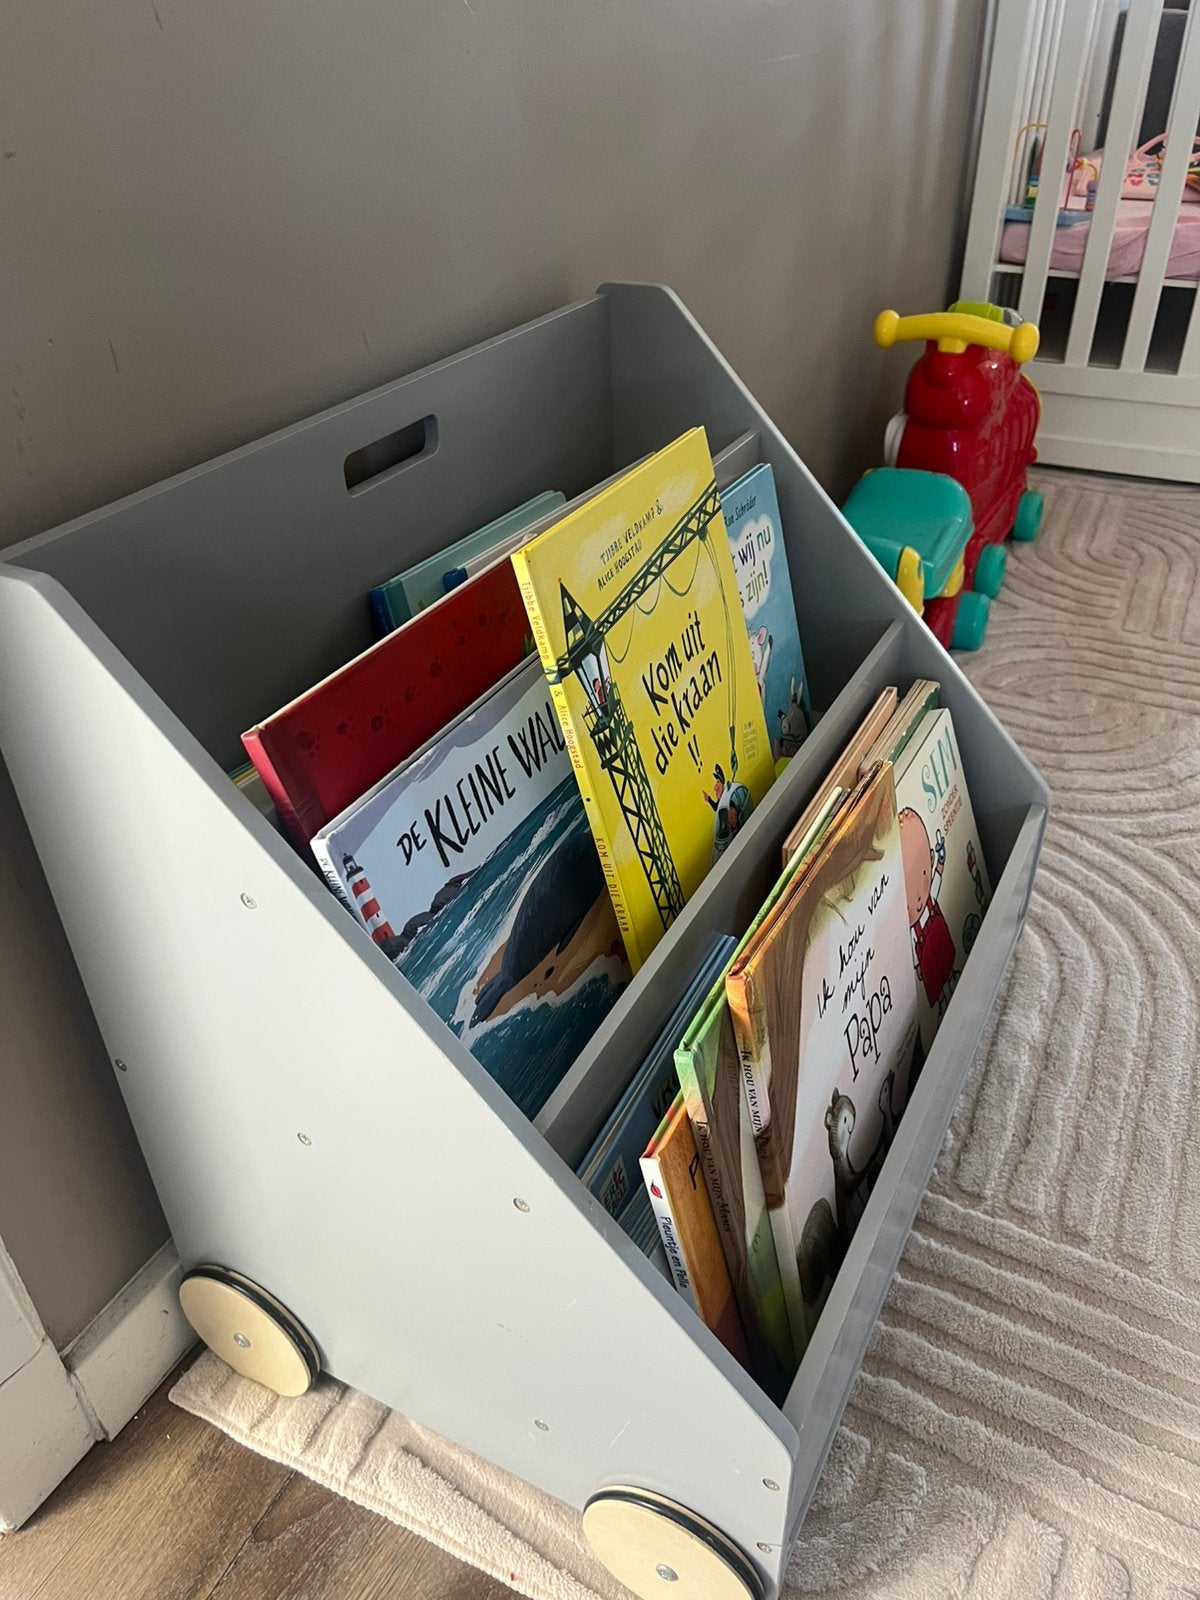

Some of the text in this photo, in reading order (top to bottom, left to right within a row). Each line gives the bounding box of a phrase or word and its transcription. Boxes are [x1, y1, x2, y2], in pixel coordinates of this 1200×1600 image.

[623, 507, 655, 544] VELDKAMP
[655, 499, 664, 515] &
[738, 533, 756, 567] wij
[757, 526, 771, 551] nu
[597, 538, 643, 591] ALICE HOOGSTAD
[745, 560, 769, 603] zijn!
[521, 581, 535, 612] Tjibbe
[532, 615, 549, 660] Veldkamp
[557, 705, 569, 726] Alice
[565, 729, 584, 769] Hoogstad
[642, 610, 706, 717] Kom uit
[650, 650, 722, 776] die kraan
[921, 725, 957, 814] SEM
[396, 820, 428, 867] DE
[423, 745, 516, 868] KLEINE
[596, 837, 630, 933] KOM UIT DIE KRAAN
[838, 924, 866, 980] hou
[867, 874, 889, 916] van
[842, 947, 875, 1014] mijn
[844, 975, 893, 1084] Papa
[743, 1065, 754, 1087] HOU
[747, 1087, 759, 1108] VAN
[752, 1108, 763, 1132] MIJN
[699, 1135, 711, 1156] HOU
[705, 1156, 717, 1179] VAN
[660, 1216, 688, 1289] Pleuntje en Pelle
